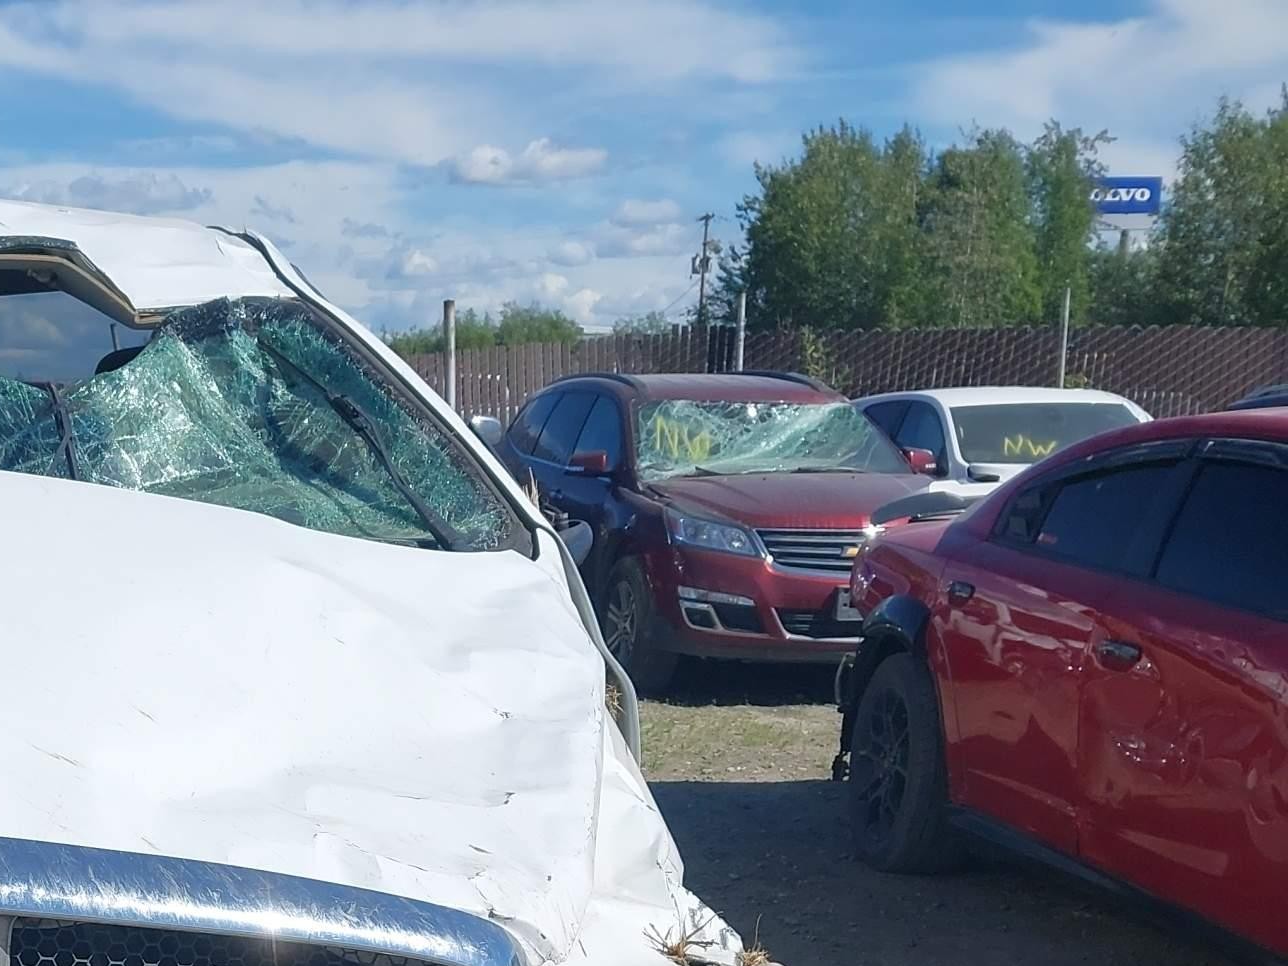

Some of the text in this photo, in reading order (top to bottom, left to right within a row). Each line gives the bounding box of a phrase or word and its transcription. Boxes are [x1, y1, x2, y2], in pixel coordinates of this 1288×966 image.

[1089, 187, 1152, 202] OLVO
[654, 416, 711, 462] NW
[1004, 433, 1057, 456] NW
